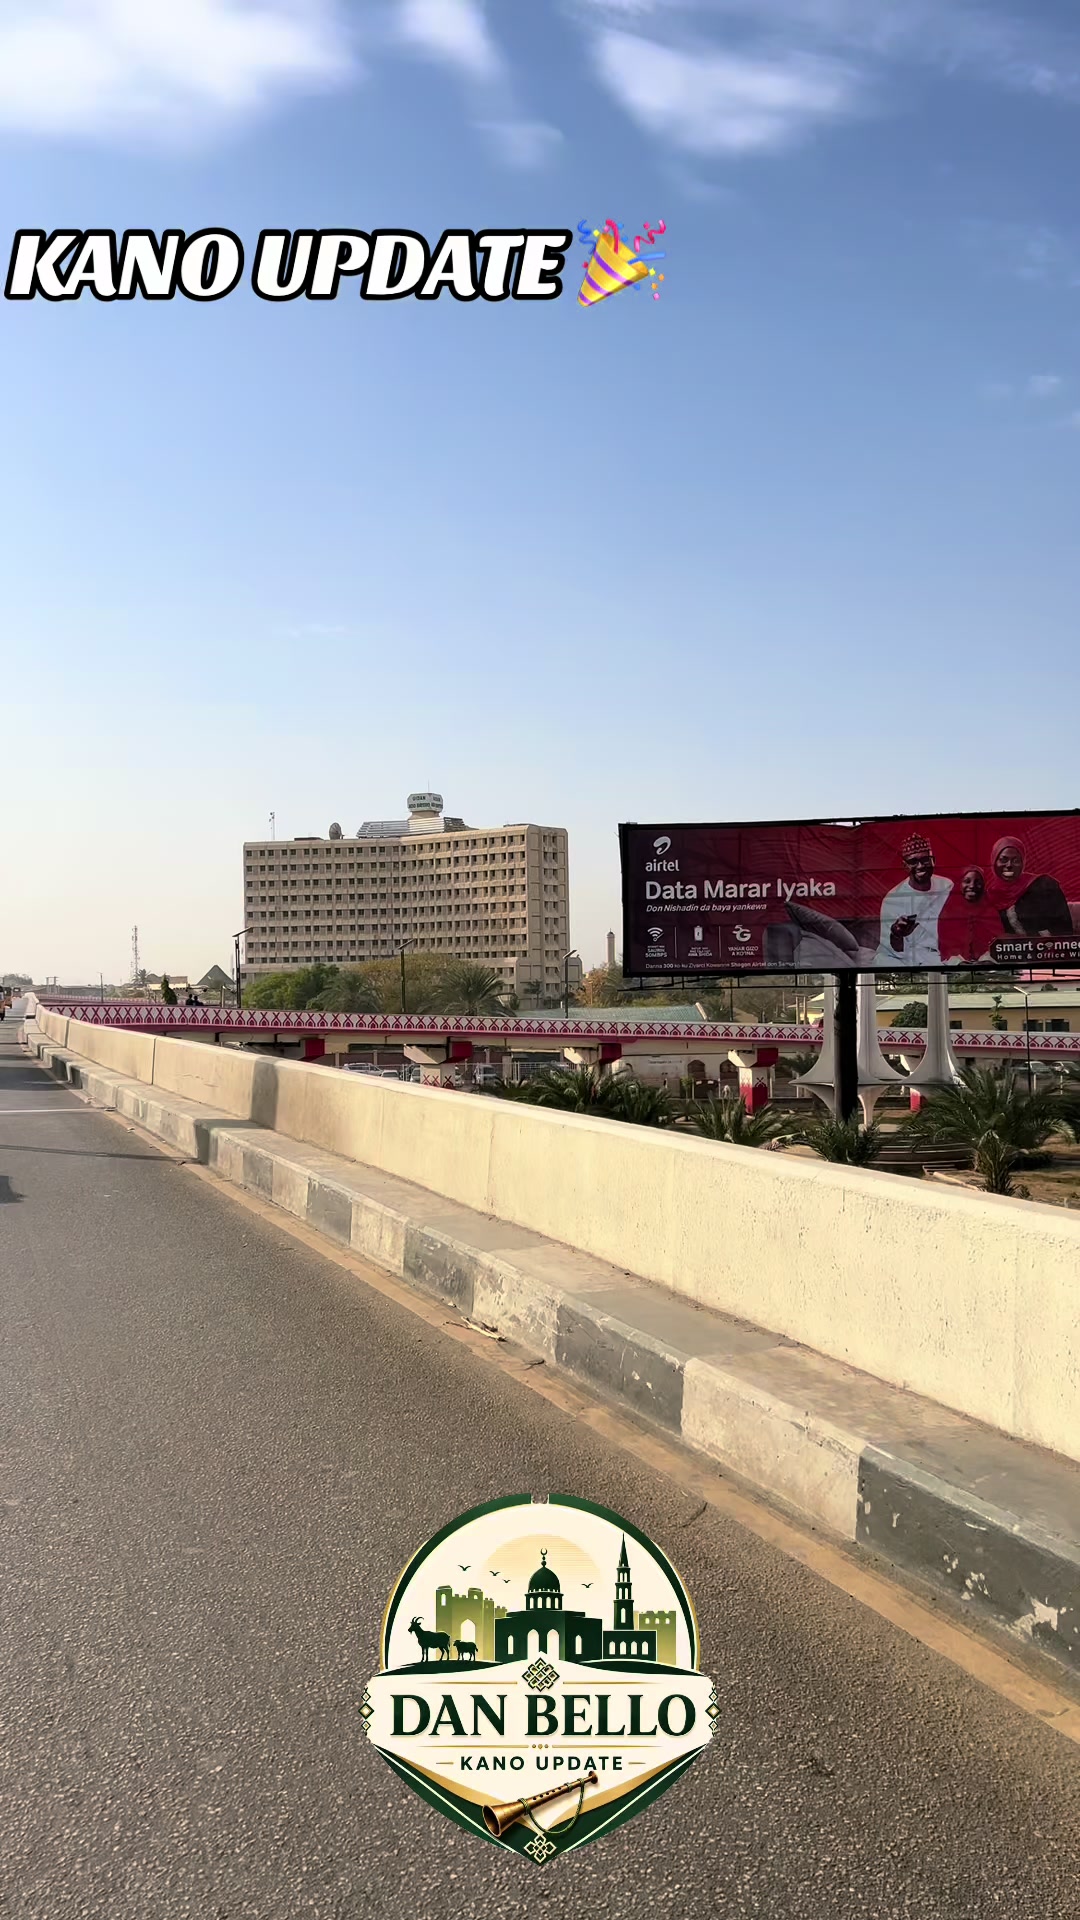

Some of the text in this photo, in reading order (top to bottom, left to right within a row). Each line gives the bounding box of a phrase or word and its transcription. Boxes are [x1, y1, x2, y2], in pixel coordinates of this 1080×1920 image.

[645, 859, 680, 872] airtel
[645, 877, 836, 902] Data Marar Iyaka
[646, 902, 767, 913] Don Nishadin da baya yankewa
[995, 941, 1034, 952] smart
